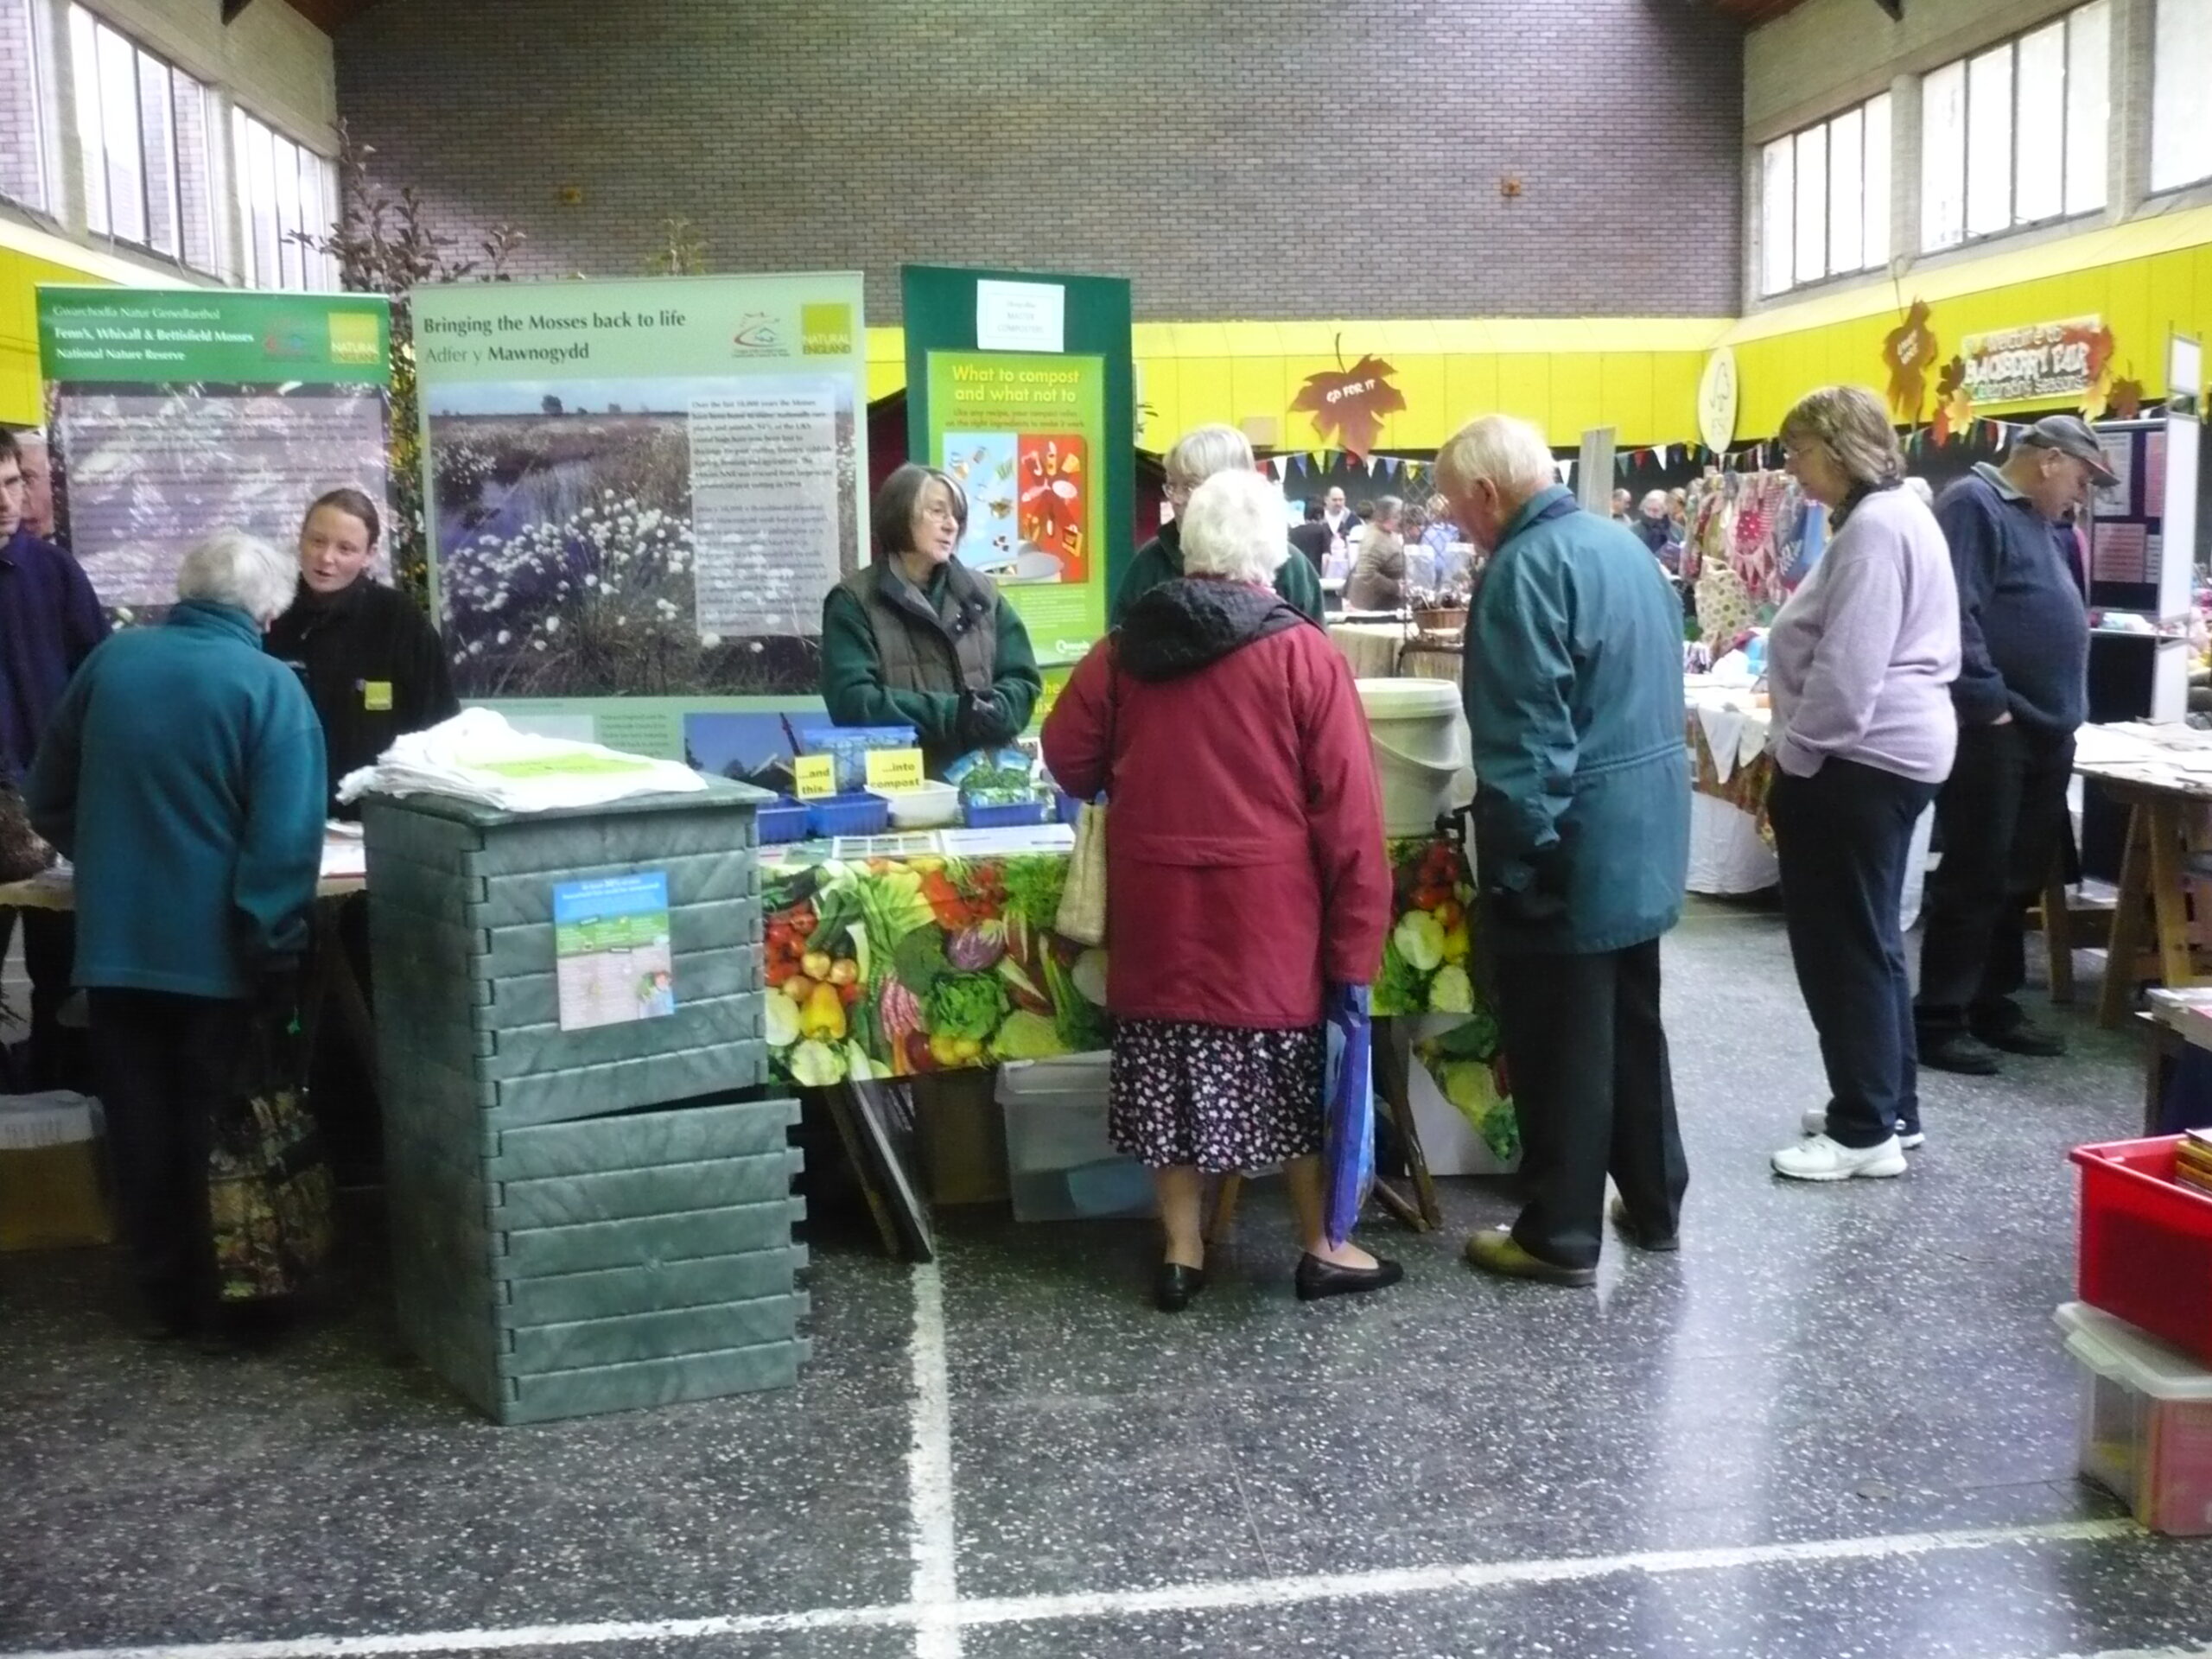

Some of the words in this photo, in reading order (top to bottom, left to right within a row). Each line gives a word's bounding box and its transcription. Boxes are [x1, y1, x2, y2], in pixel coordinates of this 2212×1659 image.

[423, 316, 493, 337] Bringing
[498, 315, 524, 332] the
[529, 315, 588, 331] Mosses
[593, 310, 632, 328] back
[638, 313, 655, 327] to
[659, 309, 686, 327] life
[144, 329, 154, 340] &
[214, 330, 254, 343] Mosses
[803, 334, 850, 345] NATURAL
[56, 347, 104, 359] National
[105, 348, 143, 359] Nature
[144, 349, 186, 360] Reserve
[425, 346, 468, 364] Adfer
[473, 350, 484, 366] y
[488, 342, 589, 365] Mawnogydd
[803, 344, 852, 355] ENGLAND
[952, 365, 995, 382] What
[999, 367, 1015, 383] to
[1019, 369, 1079, 387] compost
[955, 384, 985, 402] and
[989, 385, 1030, 402] what
[1033, 388, 1057, 403] not
[1061, 389, 1077, 404] to
[1326, 389, 1342, 404] GO
[1343, 382, 1364, 397] FOR
[1365, 378, 1376, 391] IT
[870, 778, 920, 791] compost
